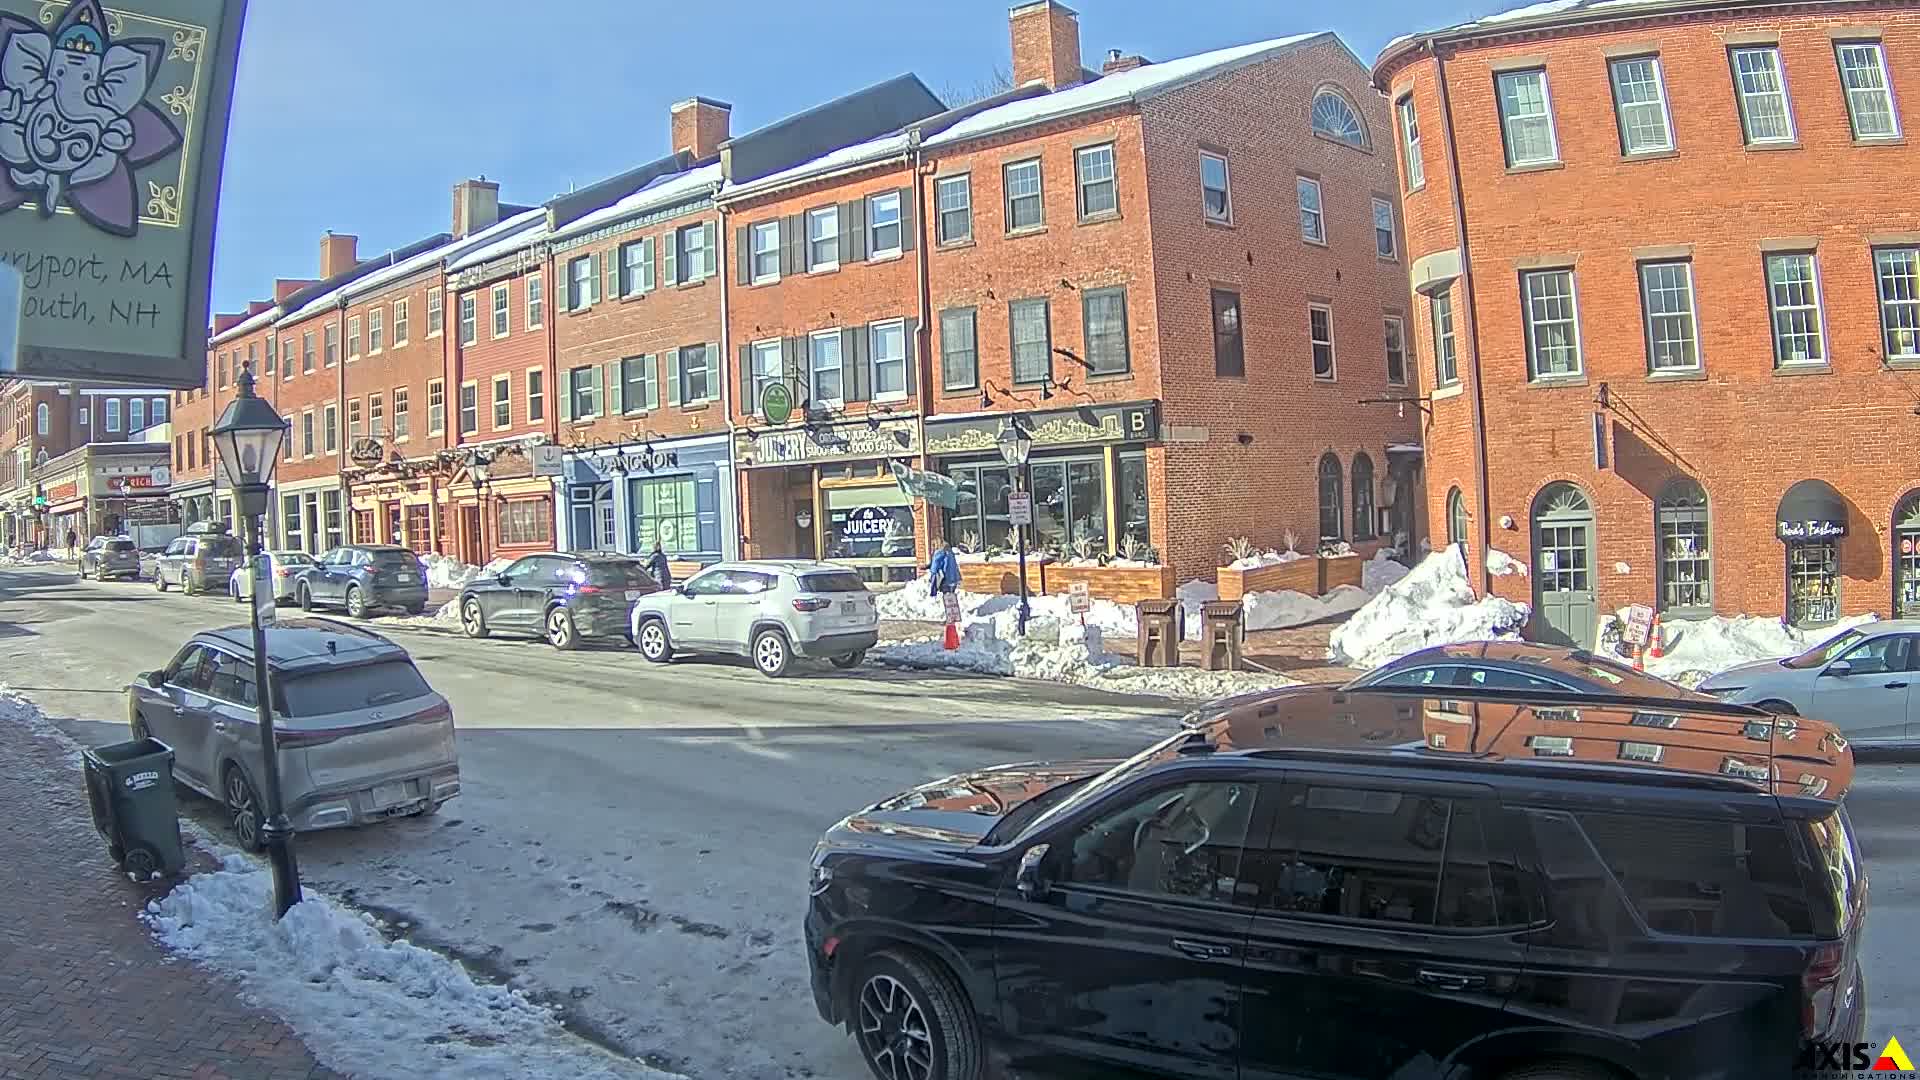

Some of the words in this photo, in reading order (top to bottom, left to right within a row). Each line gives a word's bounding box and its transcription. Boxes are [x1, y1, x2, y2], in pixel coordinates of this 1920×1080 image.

[119, 259, 173, 288] MA
[23, 291, 95, 325] outh,
[109, 299, 160, 328] NH
[1131, 412, 1145, 431] B
[756, 432, 807, 463] JUICERY
[843, 518, 895, 535] JUICERY
